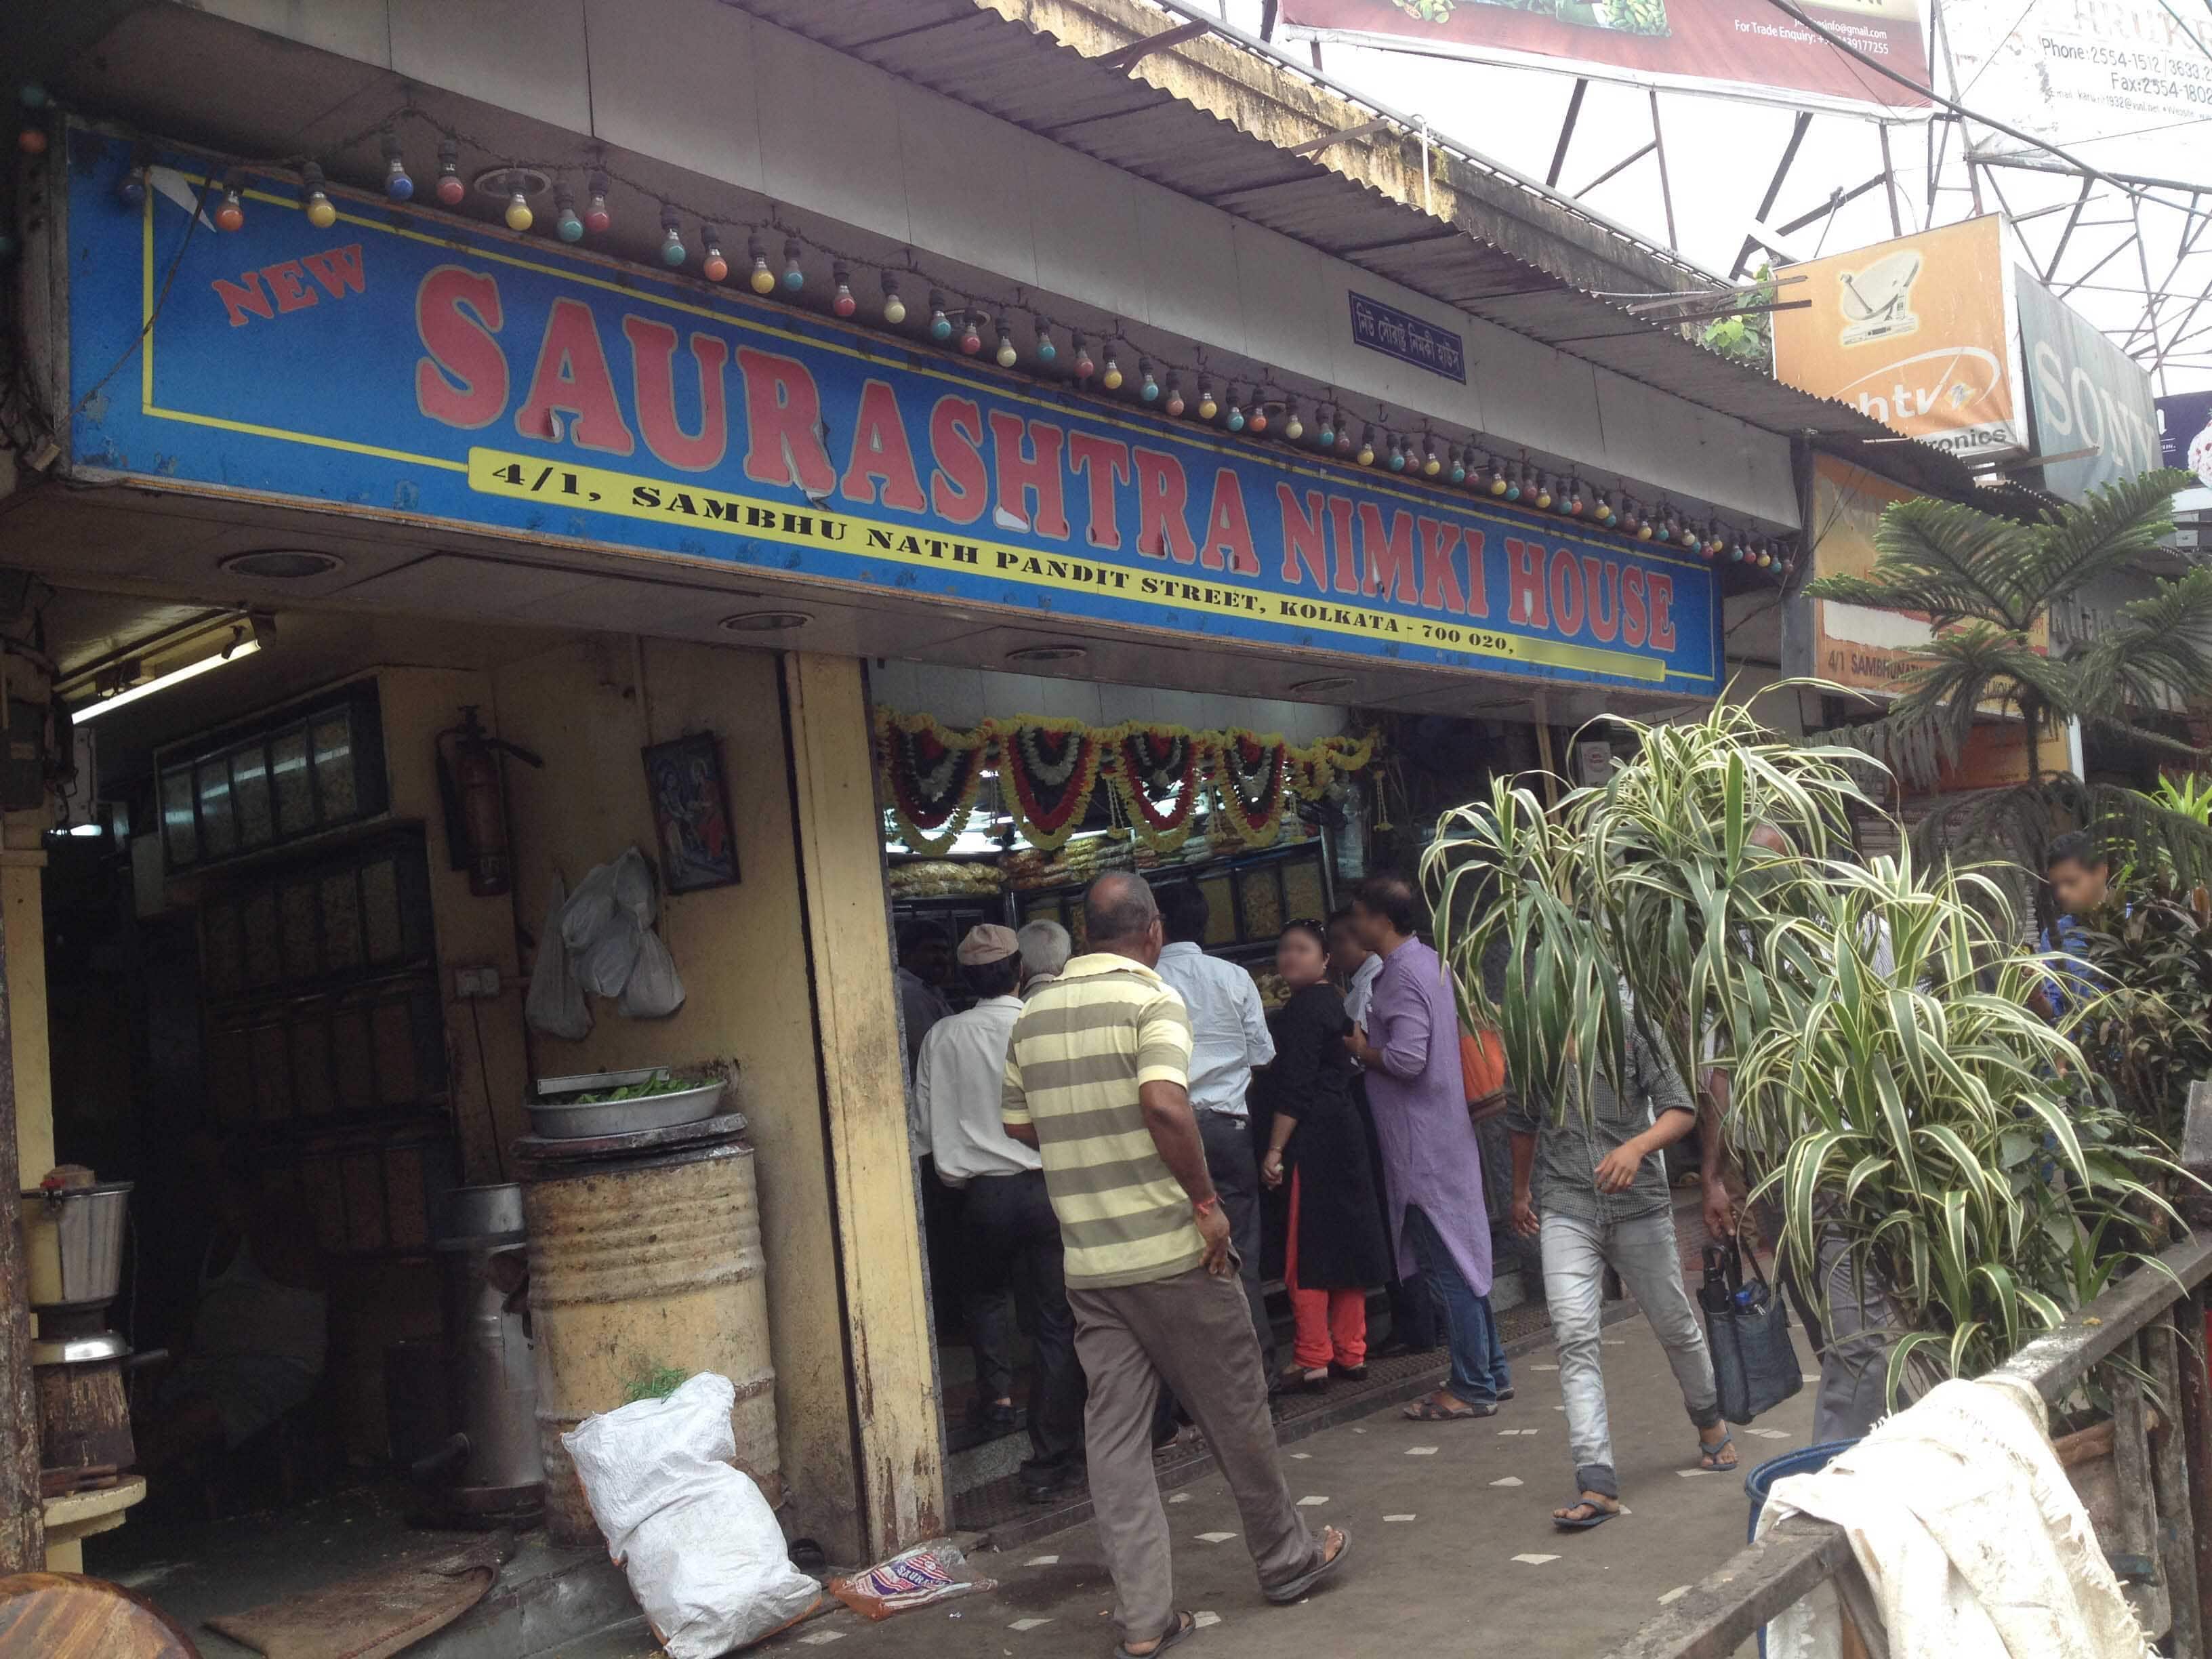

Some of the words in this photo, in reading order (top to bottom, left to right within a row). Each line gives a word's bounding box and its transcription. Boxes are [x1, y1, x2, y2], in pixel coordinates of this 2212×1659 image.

[1734, 19, 1750, 33] For
[1751, 22, 1778, 36] Trade
[1779, 26, 1817, 45] Enquiry:
[211, 244, 366, 327] NEW
[1922, 427, 2007, 453] ronics
[2034, 340, 2155, 472] SONY
[415, 264, 1262, 576] SAURASHTRA
[1275, 480, 1490, 619] NIMKI
[1503, 537, 1676, 653] HOUSE
[491, 462, 602, 503] 4/1,
[631, 485, 848, 541] SAMBHU
[865, 528, 979, 565] NATH
[996, 551, 1130, 590] PANDIT
[1141, 577, 1268, 615] STREET,
[1279, 601, 1399, 633] KOLKATA
[1422, 623, 1461, 644] 700
[1469, 632, 1515, 655] 020,
[1827, 650, 1845, 672] 4/1
